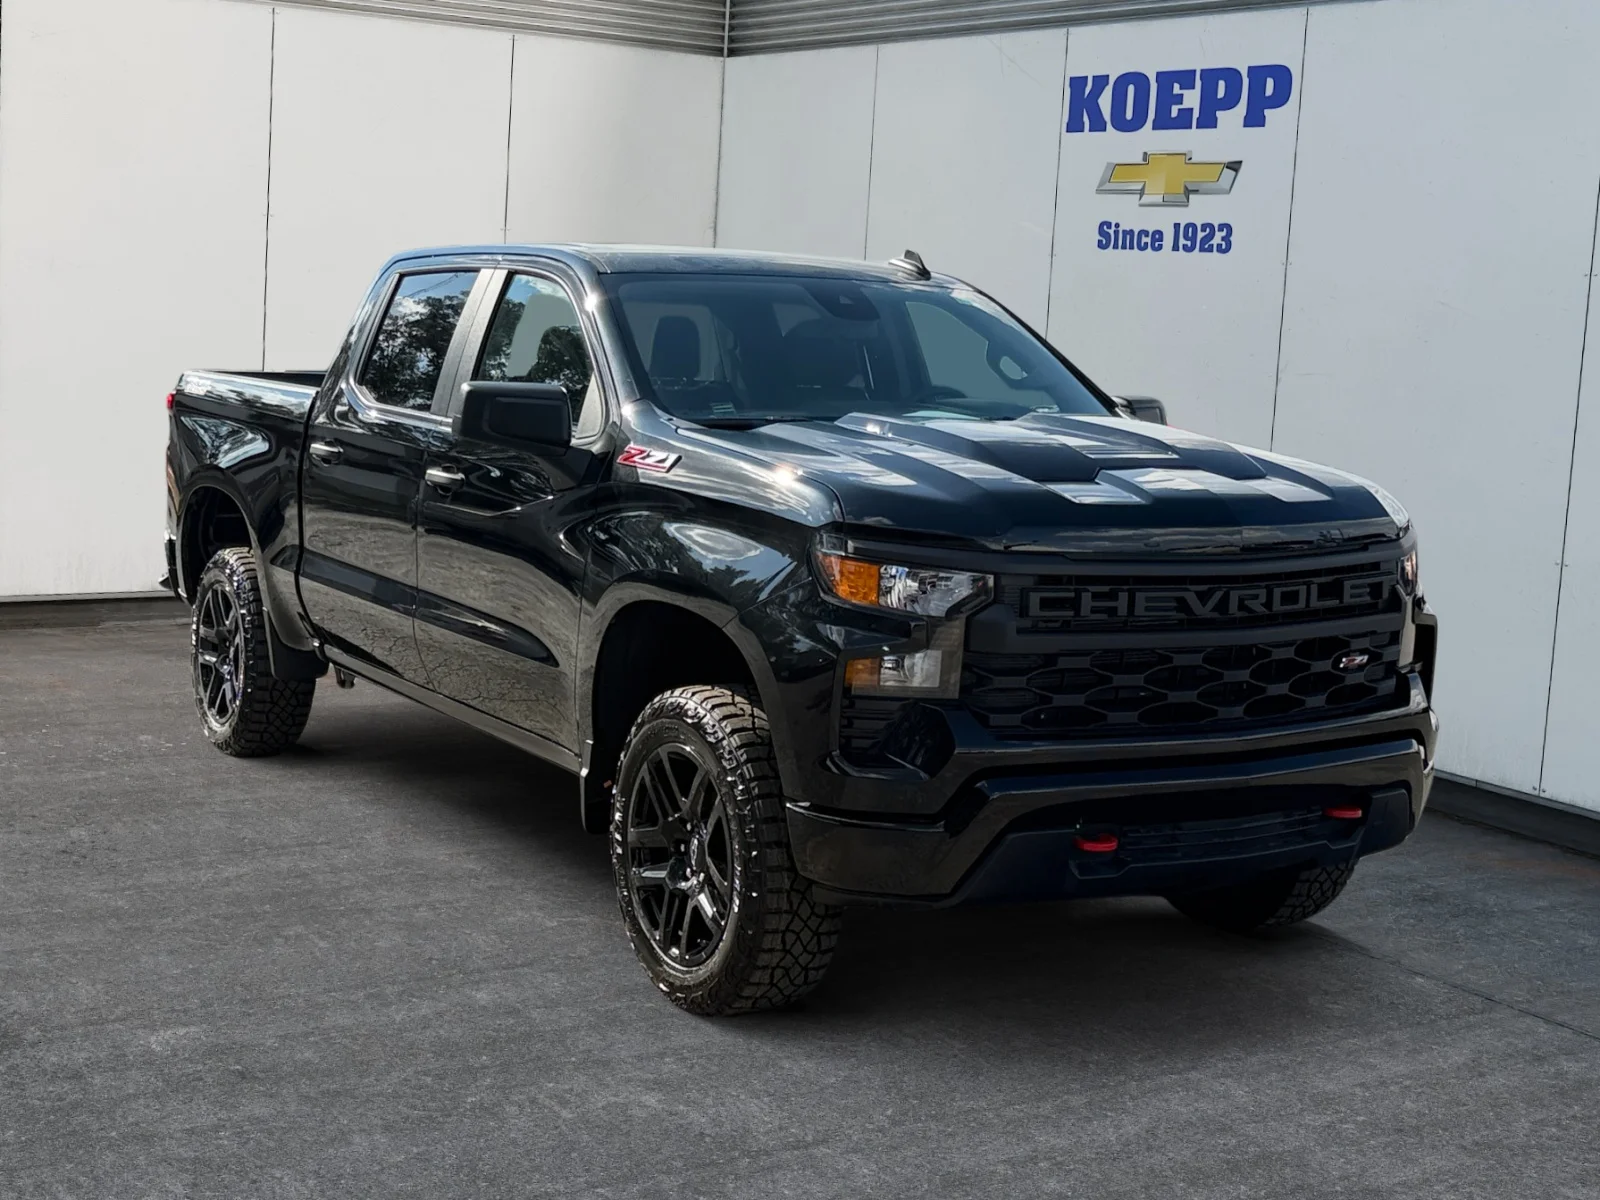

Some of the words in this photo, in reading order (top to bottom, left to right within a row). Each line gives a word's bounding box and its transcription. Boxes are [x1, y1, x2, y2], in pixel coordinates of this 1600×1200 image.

[1066, 64, 1293, 133] KOEPP
[1097, 221, 1164, 252] Since
[1171, 222, 1233, 254] 1923
[616, 443, 682, 473] Z71
[1026, 576, 1396, 618] CHEVROLET
